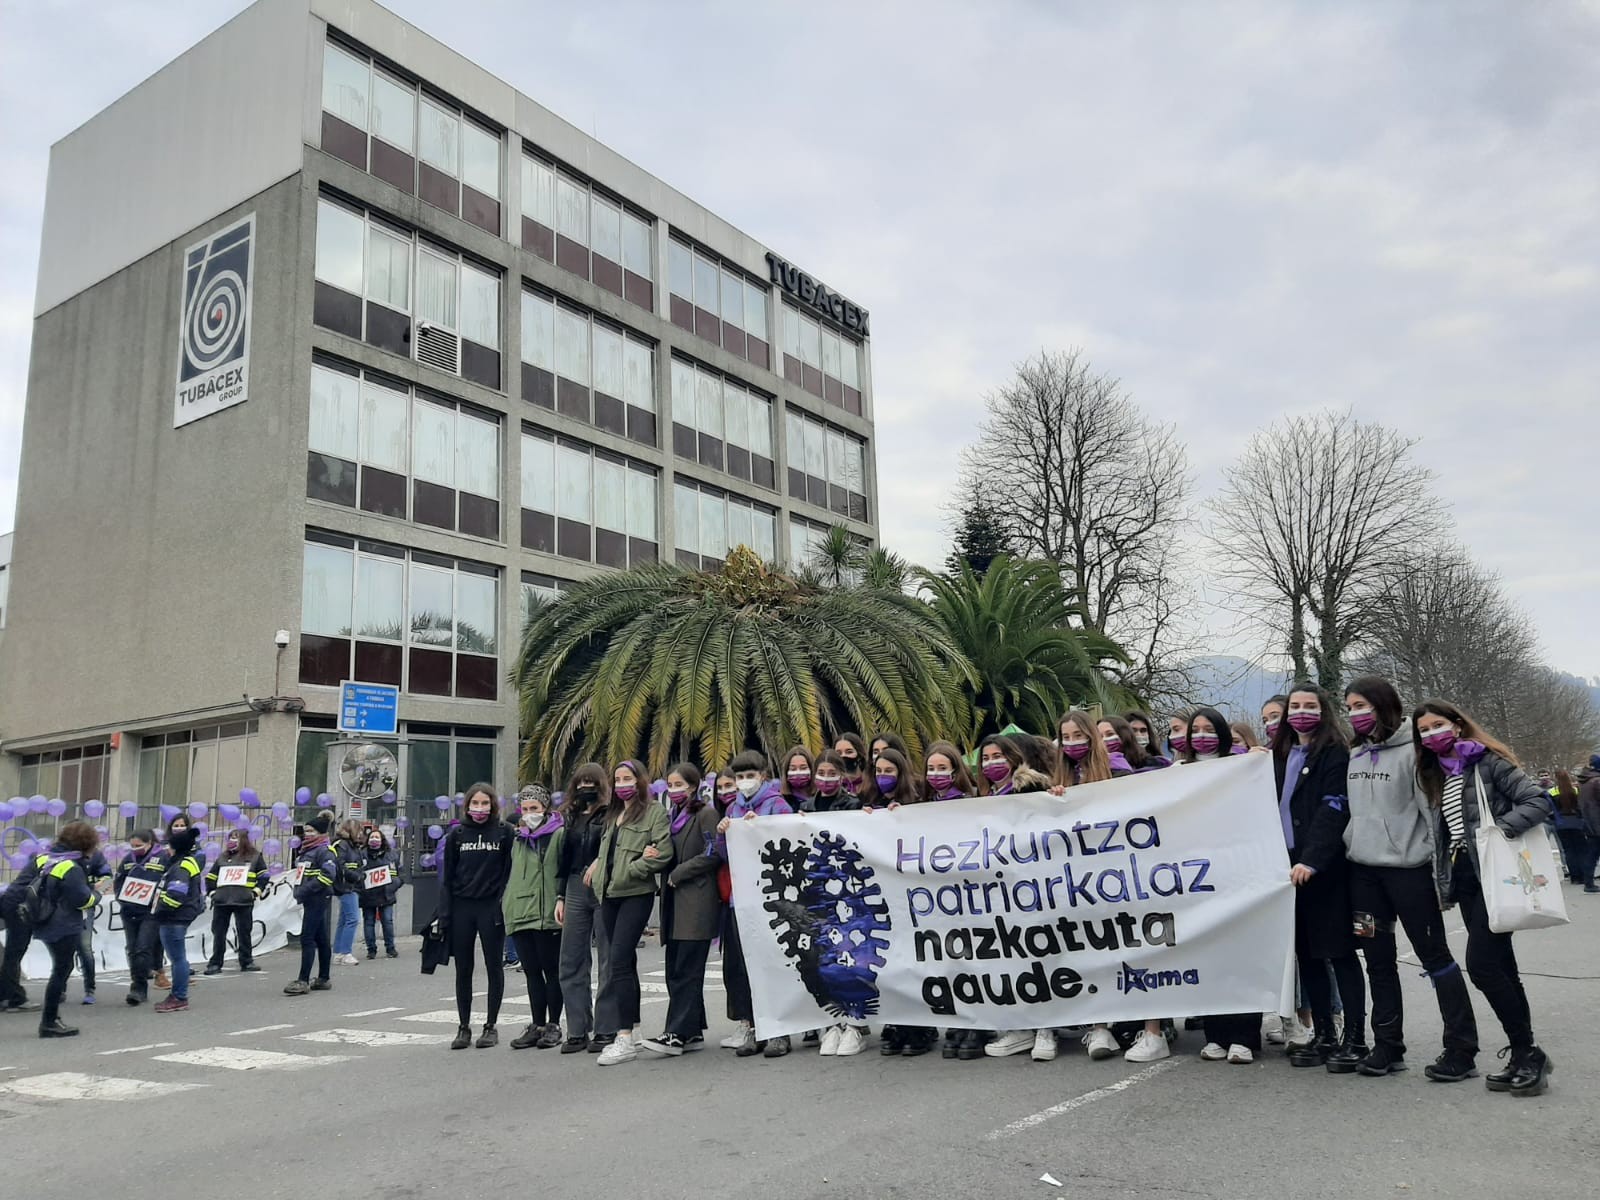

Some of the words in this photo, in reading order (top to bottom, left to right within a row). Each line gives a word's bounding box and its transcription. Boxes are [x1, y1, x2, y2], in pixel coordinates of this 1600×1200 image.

[765, 252, 869, 336] TUBACEX
[180, 366, 243, 406] TUBACEX
[219, 386, 242, 402] GROUP
[896, 815, 1161, 874] Hezkuntza
[123, 880, 153, 899] 073
[224, 868, 245, 881] 145
[369, 868, 387, 884] 105
[906, 853, 1215, 927] patriarkalaz
[914, 911, 1177, 961] nazkatuta
[922, 961, 1098, 1015] gaude.
